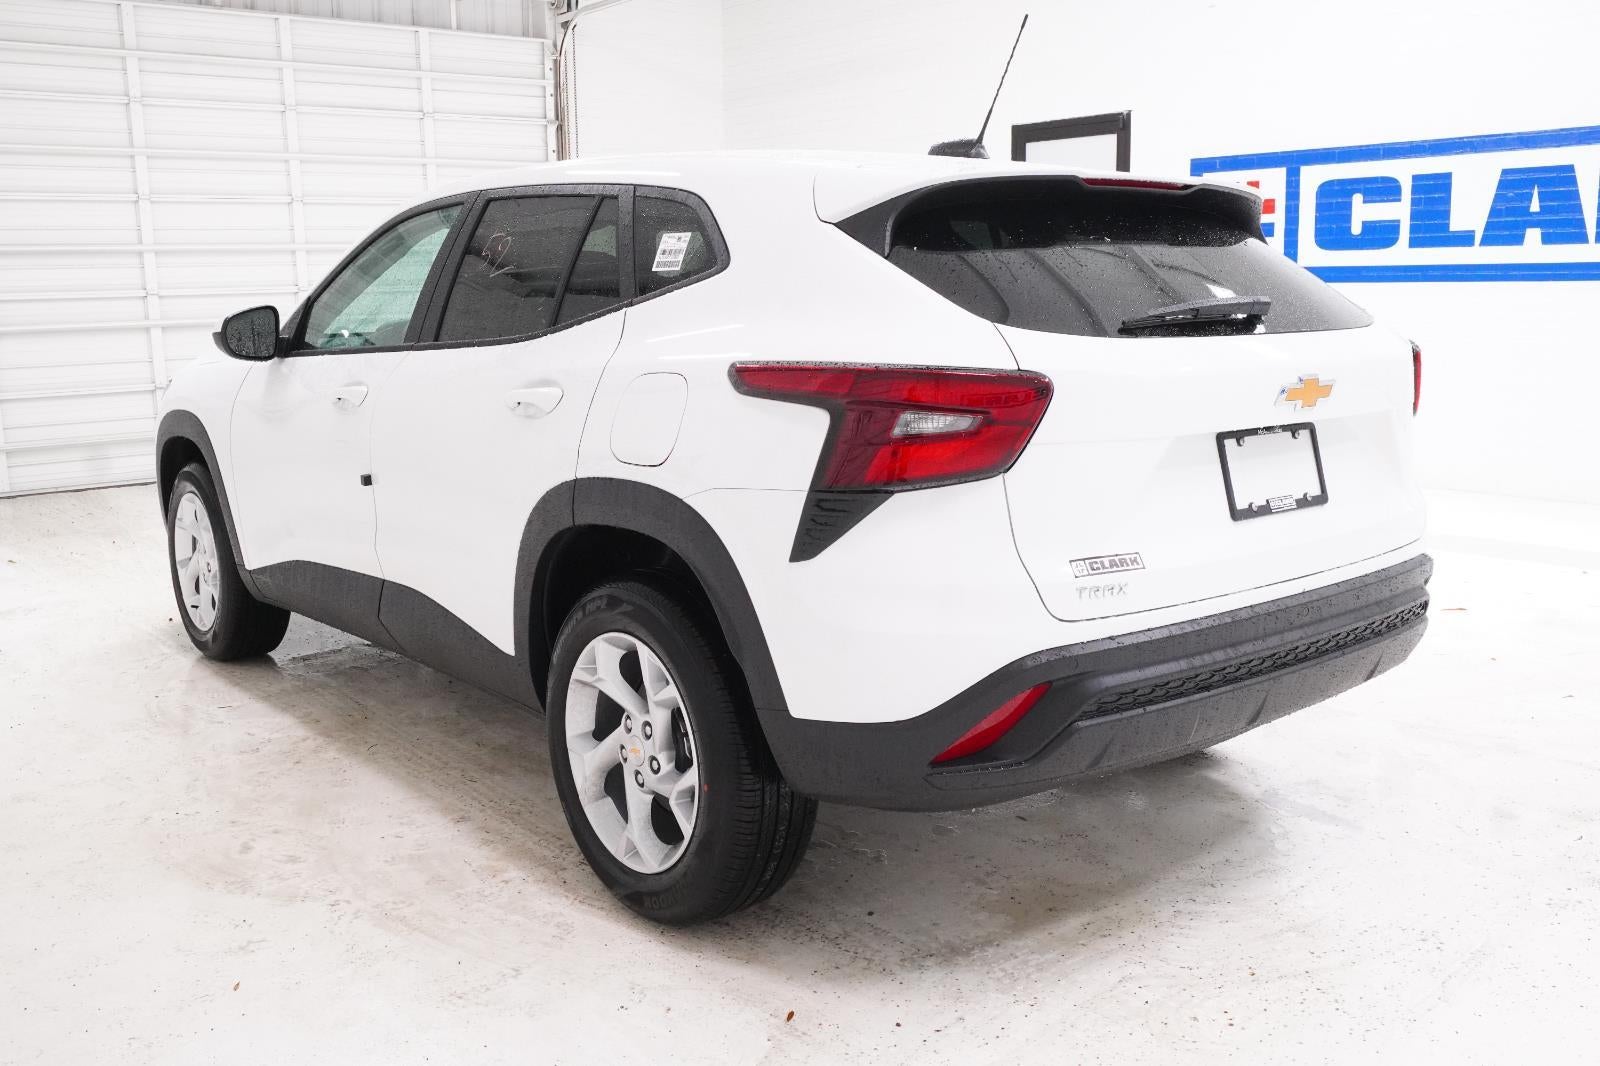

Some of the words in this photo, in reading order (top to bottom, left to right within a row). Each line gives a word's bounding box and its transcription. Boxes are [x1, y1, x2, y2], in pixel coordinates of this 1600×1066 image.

[1314, 164, 1600, 250] CLA
[1088, 556, 1141, 571] CLARK
[1076, 582, 1129, 600] TRAX
